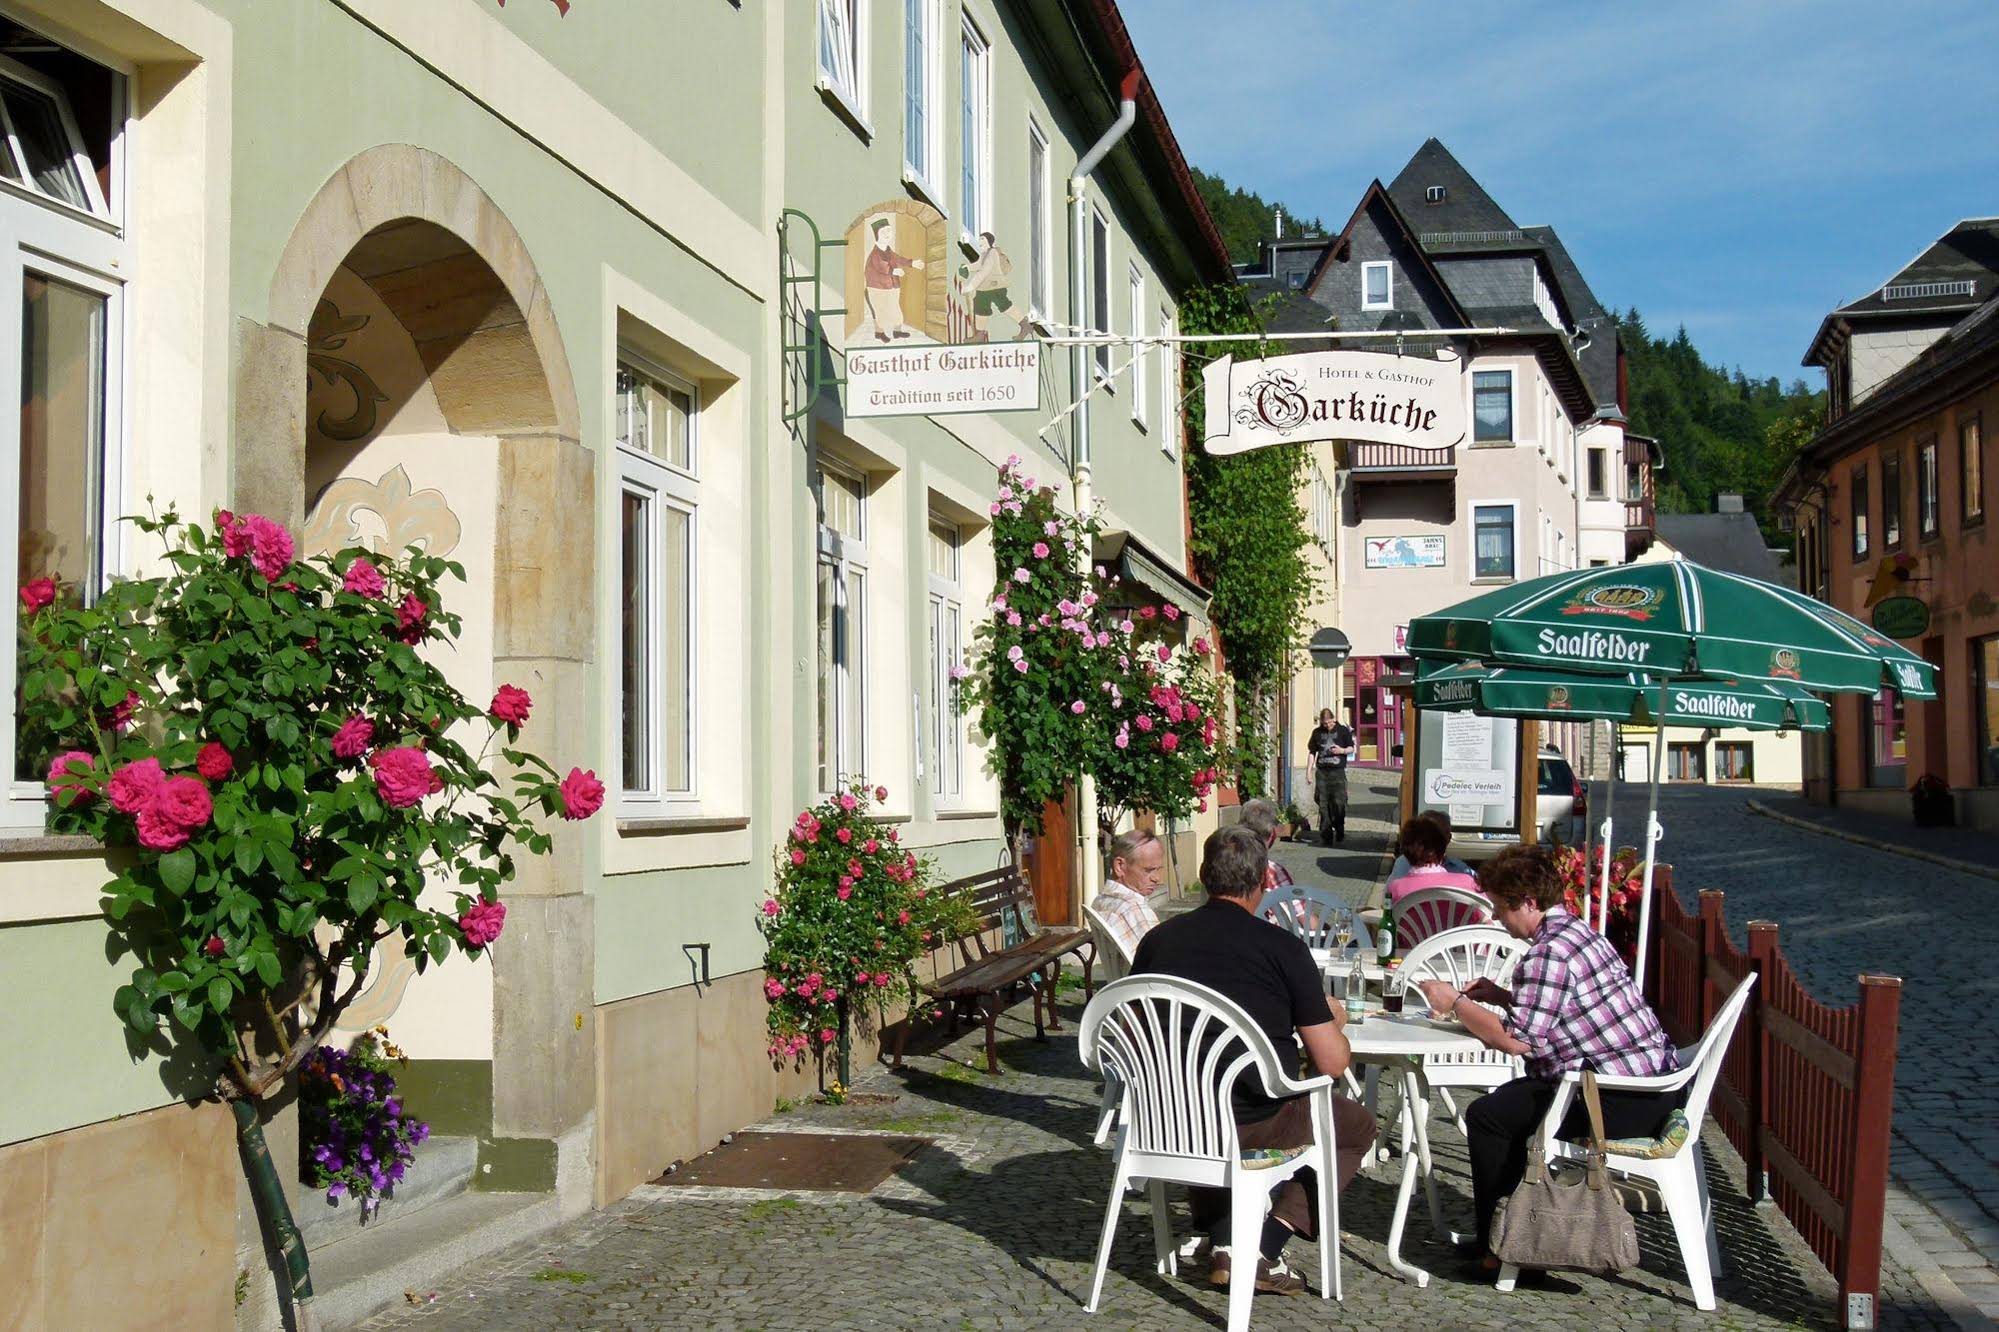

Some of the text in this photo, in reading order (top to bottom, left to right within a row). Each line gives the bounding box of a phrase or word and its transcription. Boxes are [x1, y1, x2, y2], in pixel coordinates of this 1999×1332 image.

[850, 349, 1036, 377] Gasthof Garküche
[1319, 367, 1436, 388] HOTEL & GASTHOF
[870, 385, 1015, 406] Tradition seit 1650
[1238, 369, 1438, 435] Garküche
[1537, 628, 1650, 662] Saalfelder
[1675, 692, 1756, 719] Saalfelder
[1441, 782, 1473, 790] Pedelec
